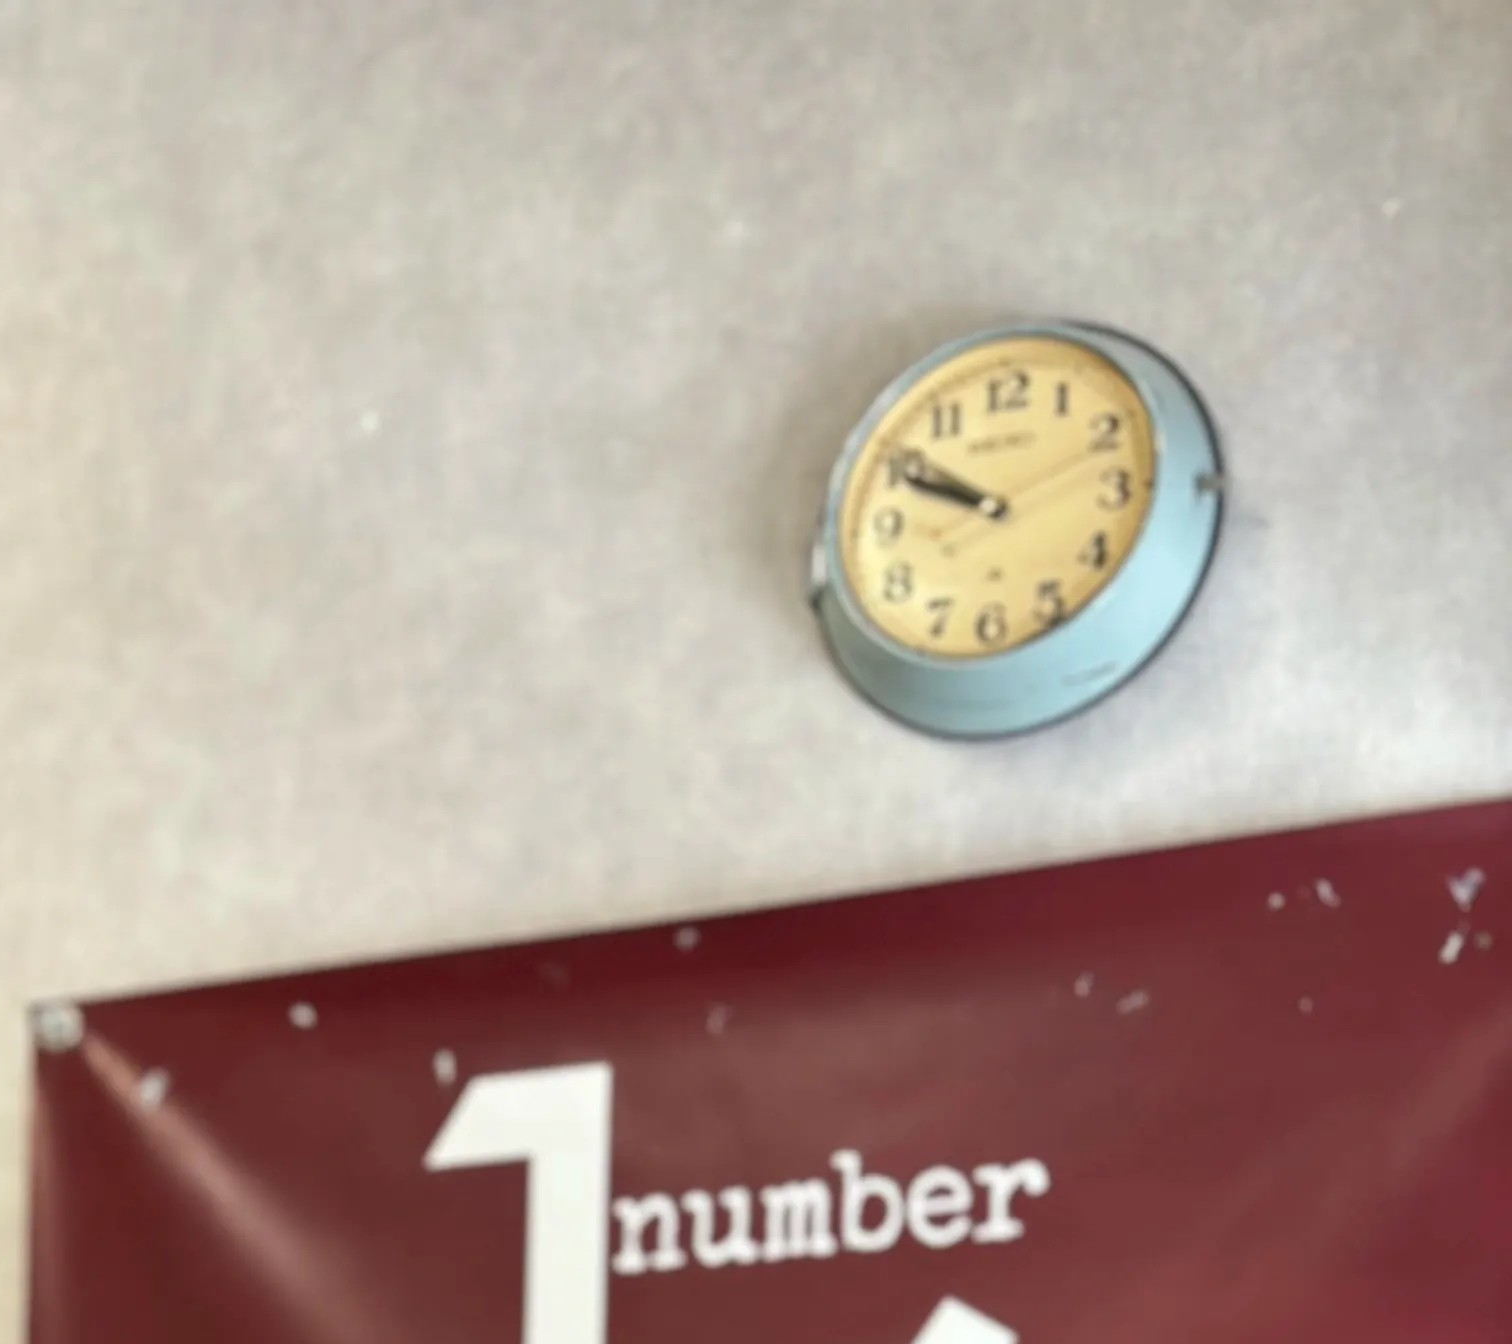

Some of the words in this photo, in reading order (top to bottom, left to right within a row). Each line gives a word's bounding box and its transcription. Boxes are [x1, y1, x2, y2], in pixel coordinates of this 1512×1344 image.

[987, 371, 1029, 413] 12
[1055, 382, 1069, 416] 1
[930, 402, 962, 439] 11
[1090, 413, 1120, 452] 2
[1098, 469, 1131, 510] 3
[874, 508, 904, 546] 9
[1078, 532, 1108, 570] 4
[884, 564, 913, 602] 8
[926, 598, 954, 637] 7
[975, 604, 1007, 644] 6
[1034, 581, 1065, 628] 5
[612, 1149, 1050, 1275] number
